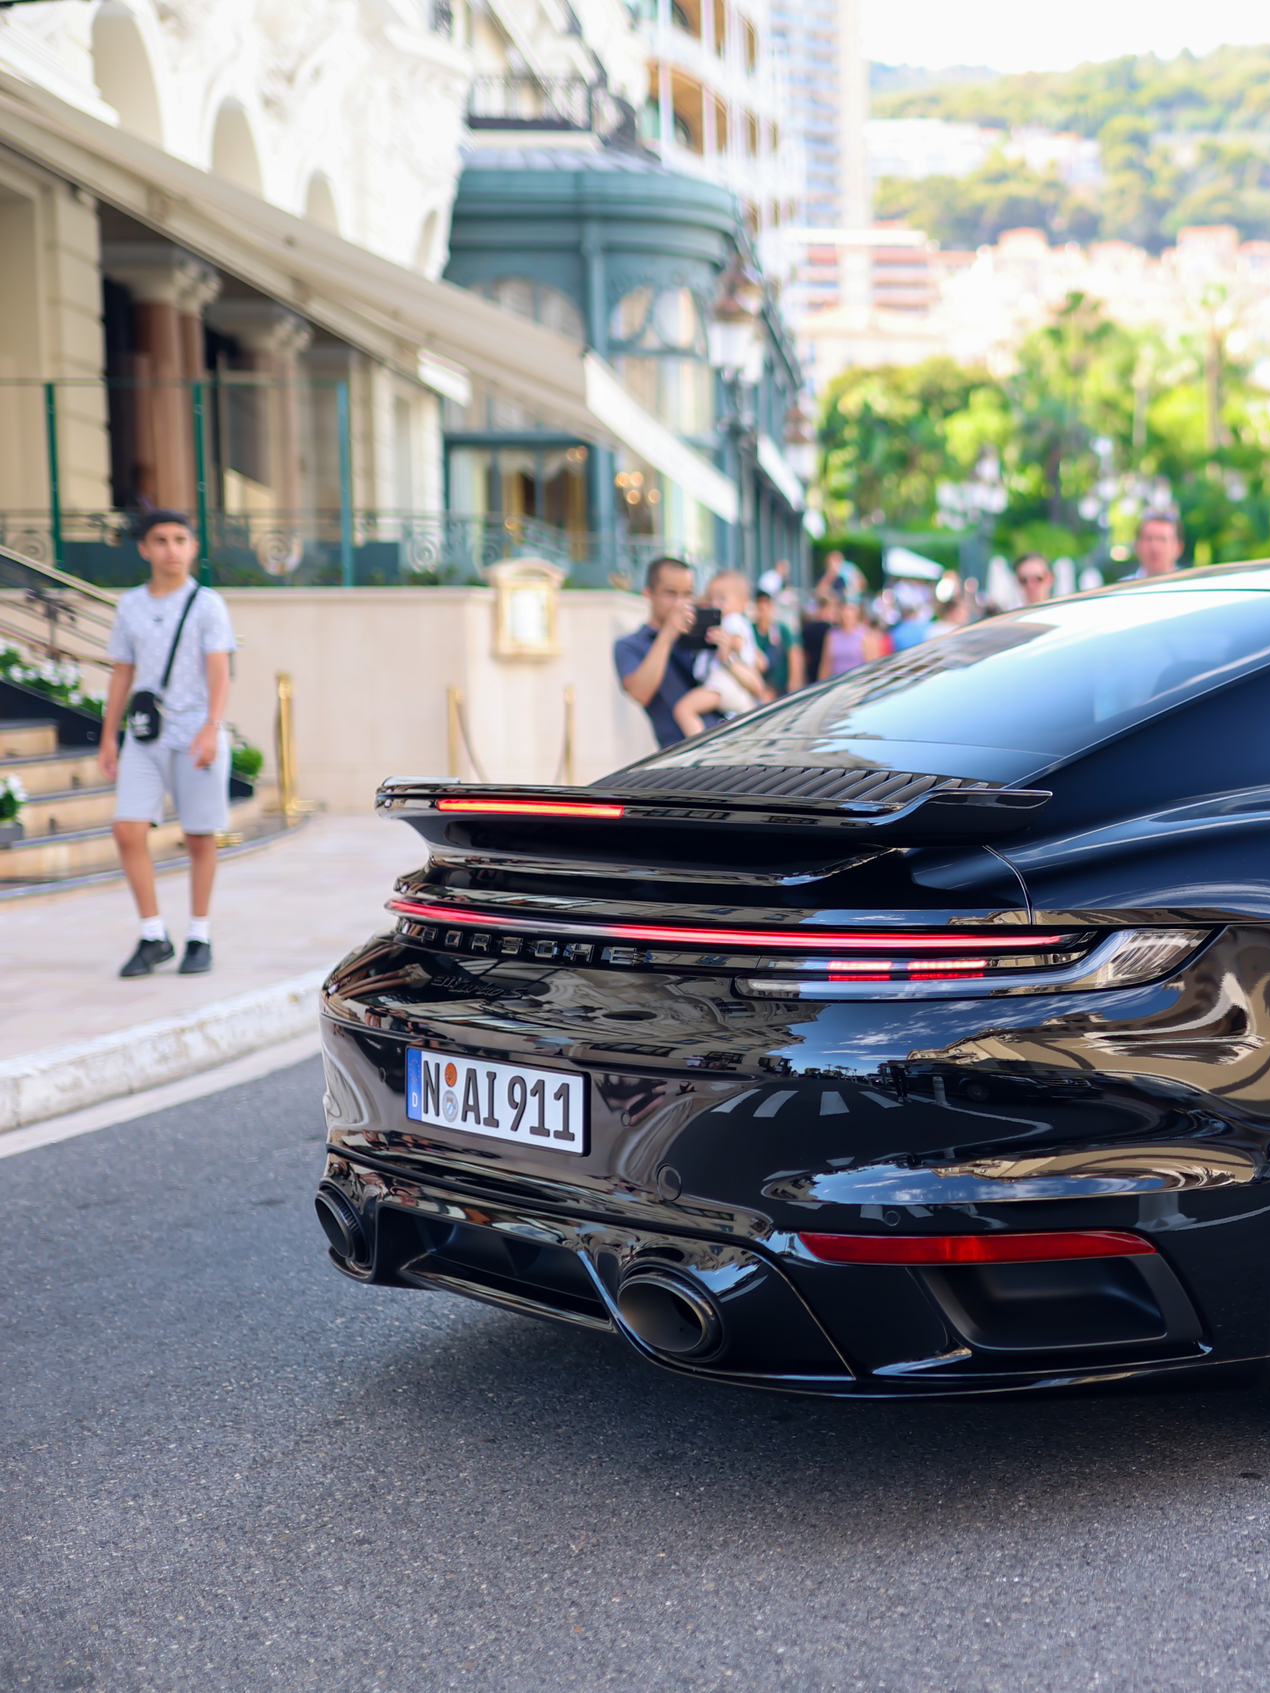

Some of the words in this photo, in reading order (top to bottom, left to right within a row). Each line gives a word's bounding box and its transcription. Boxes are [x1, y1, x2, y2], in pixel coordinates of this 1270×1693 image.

[416, 926, 638, 966] PORSCHE
[503, 987, 528, 999] S
[411, 1092, 419, 1108] D
[423, 1060, 440, 1117] N
[461, 1067, 499, 1129] AI
[507, 1075, 575, 1142] 911
